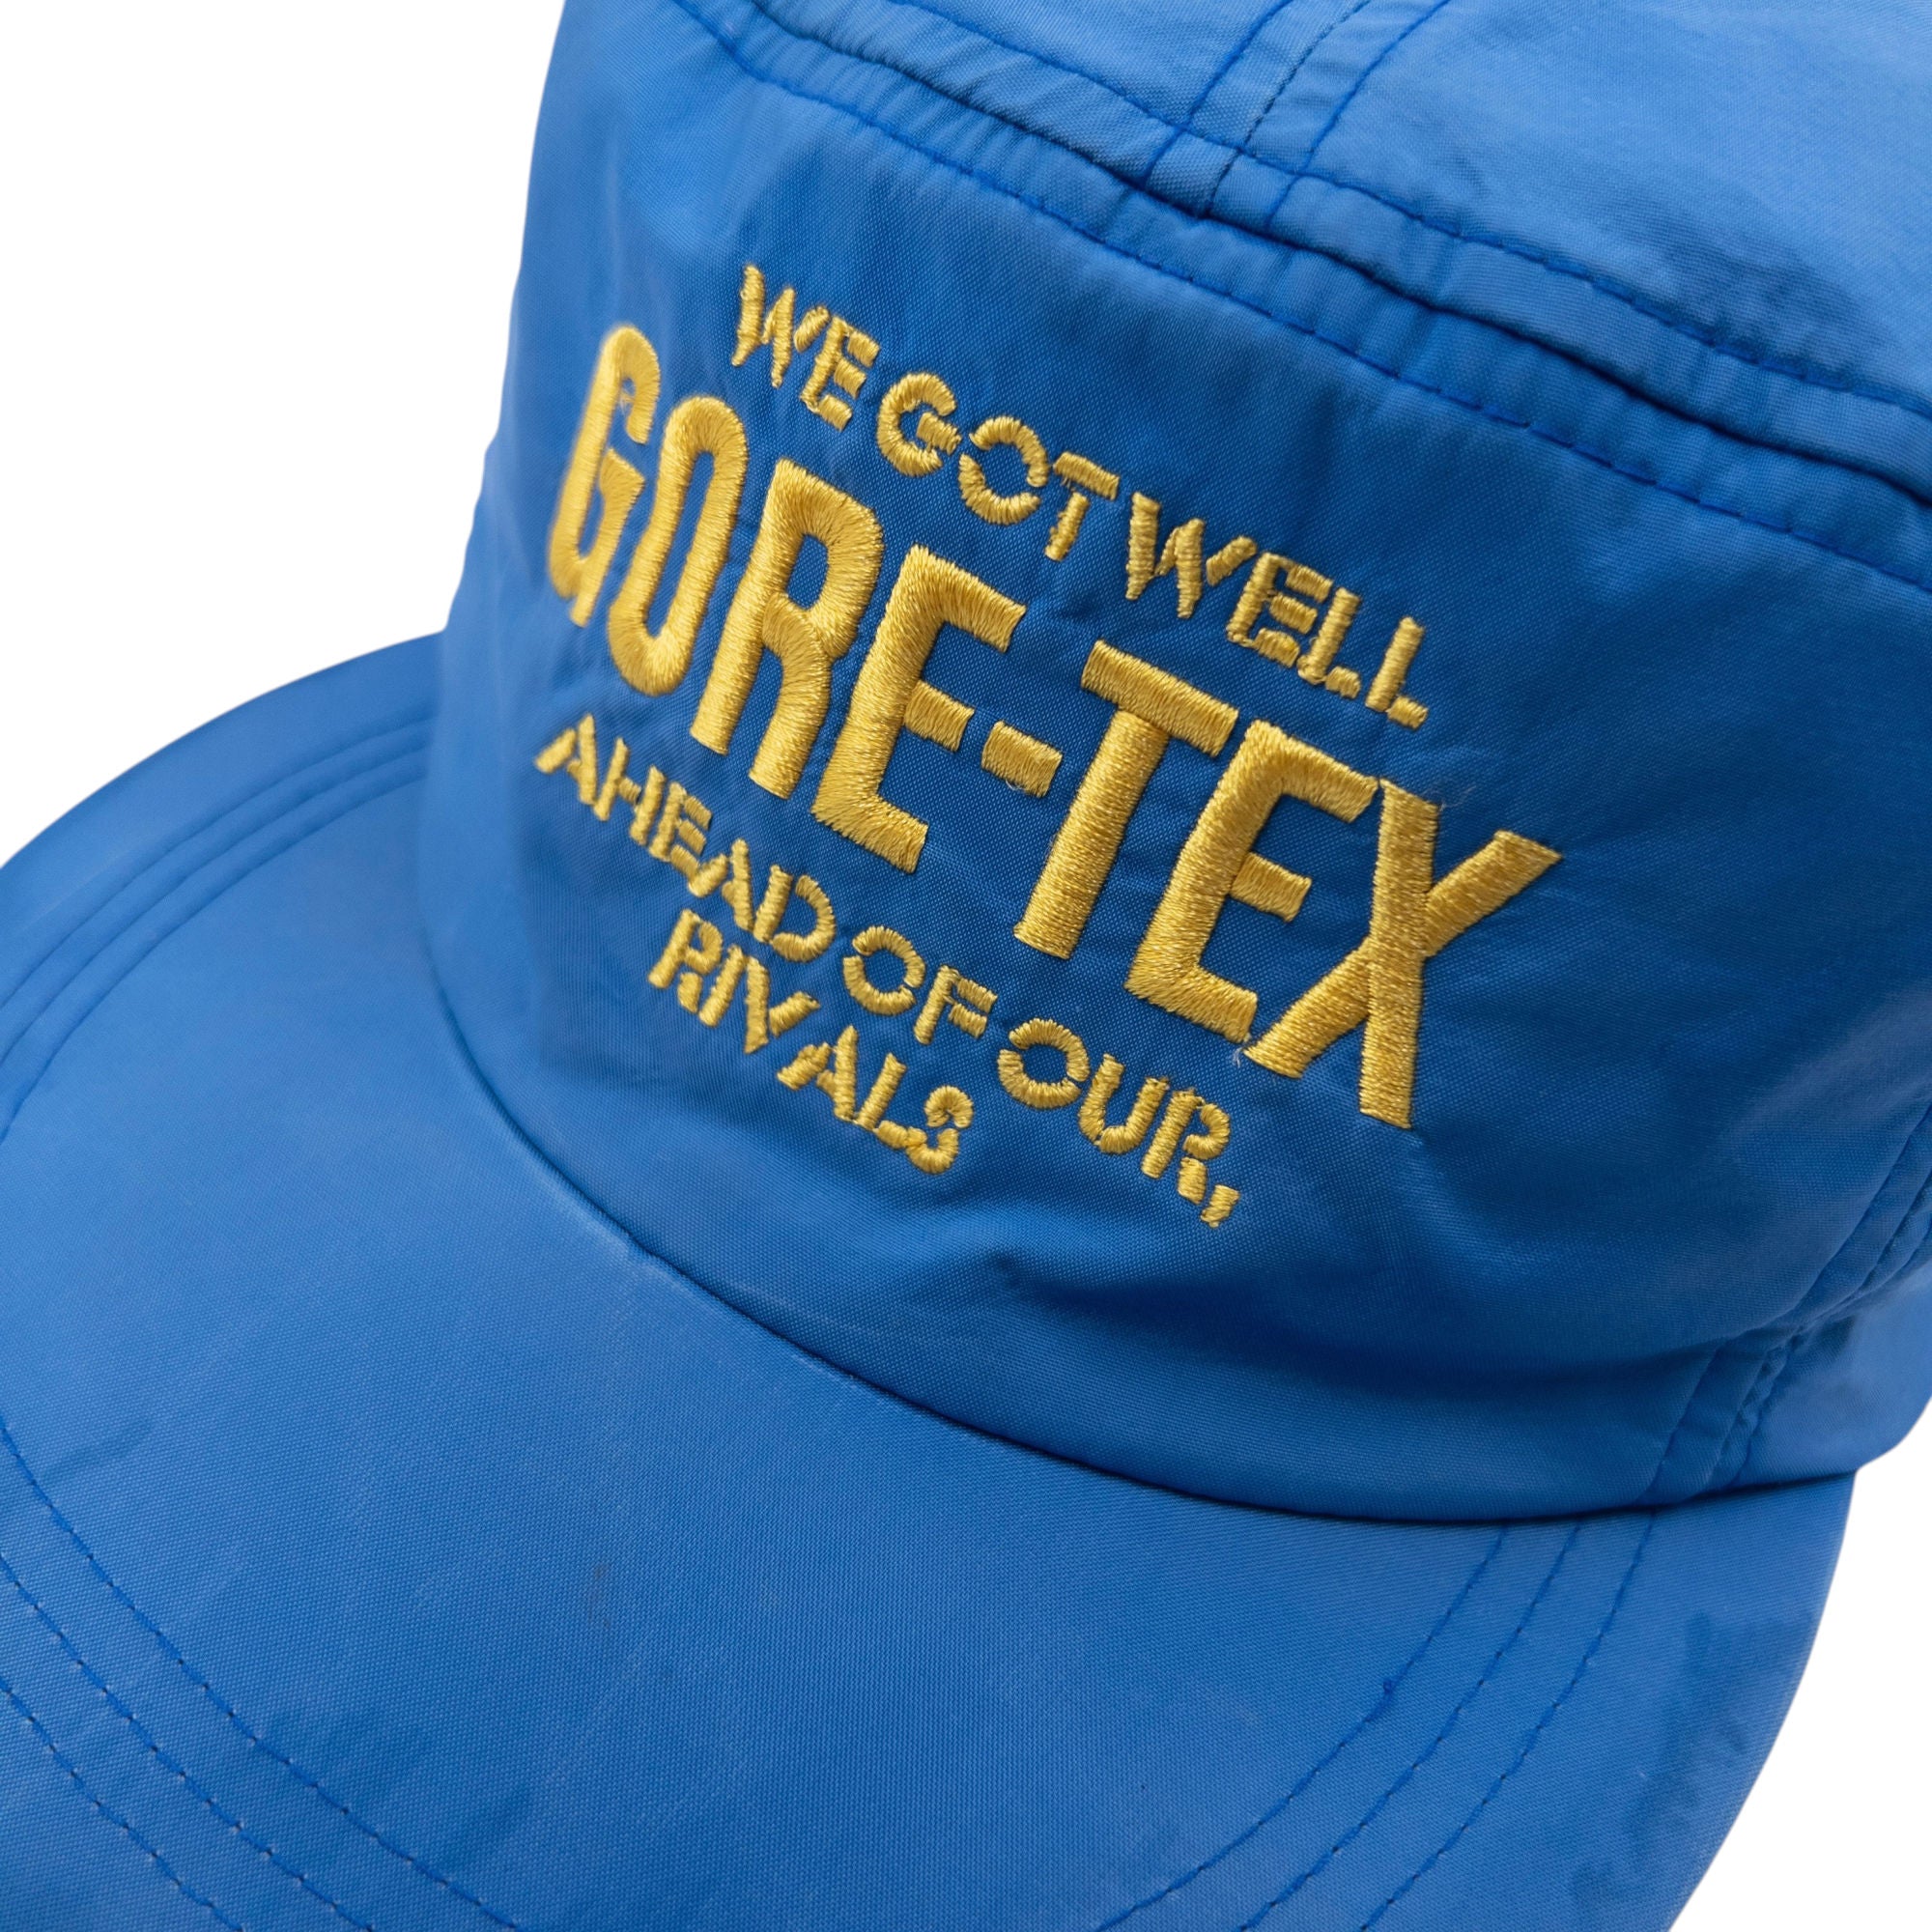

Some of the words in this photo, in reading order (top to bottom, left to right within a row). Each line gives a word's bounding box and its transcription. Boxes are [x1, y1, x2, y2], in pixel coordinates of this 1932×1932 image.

[549, 325, 1562, 1129] GORE-TEX
[731, 265, 879, 430] WE
[876, 372, 1120, 561] GOT
[1125, 492, 1428, 729] WELL
[536, 715, 836, 962] AHEAD
[842, 925, 998, 1044] OF
[997, 1017, 1240, 1228] OUR,
[648, 909, 974, 1174] RIVALS
